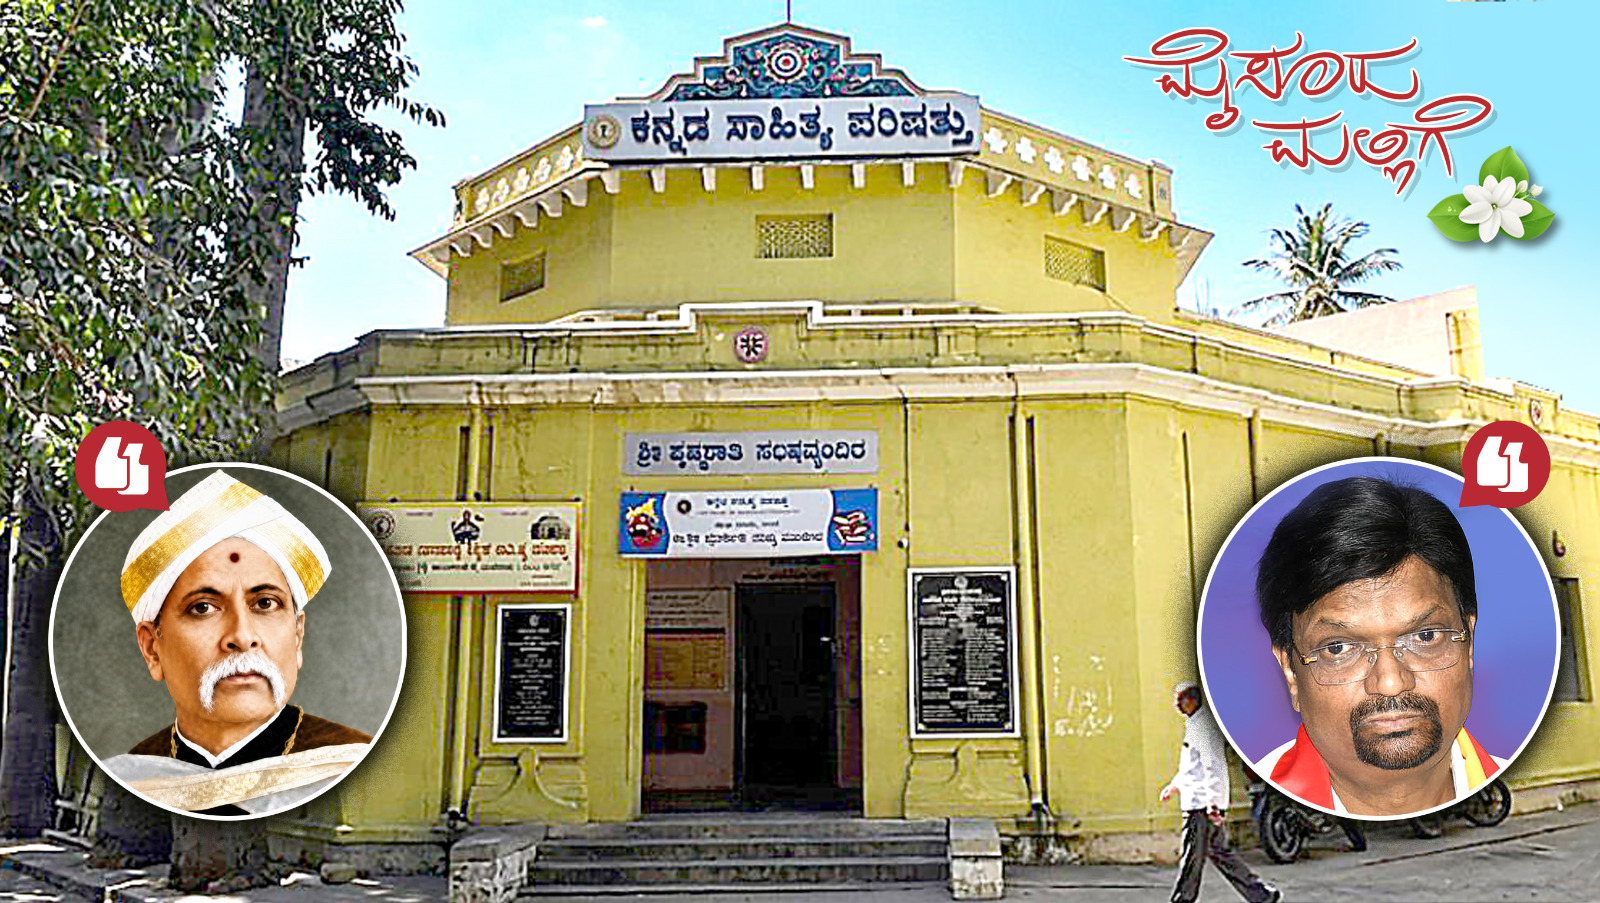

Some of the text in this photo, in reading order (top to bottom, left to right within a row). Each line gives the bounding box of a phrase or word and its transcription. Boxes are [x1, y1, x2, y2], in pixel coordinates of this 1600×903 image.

[630, 102, 975, 155] ಕನ್ನಡ ಸಾಹಿತ್ಯ ಪರಿಷತ್ತು
